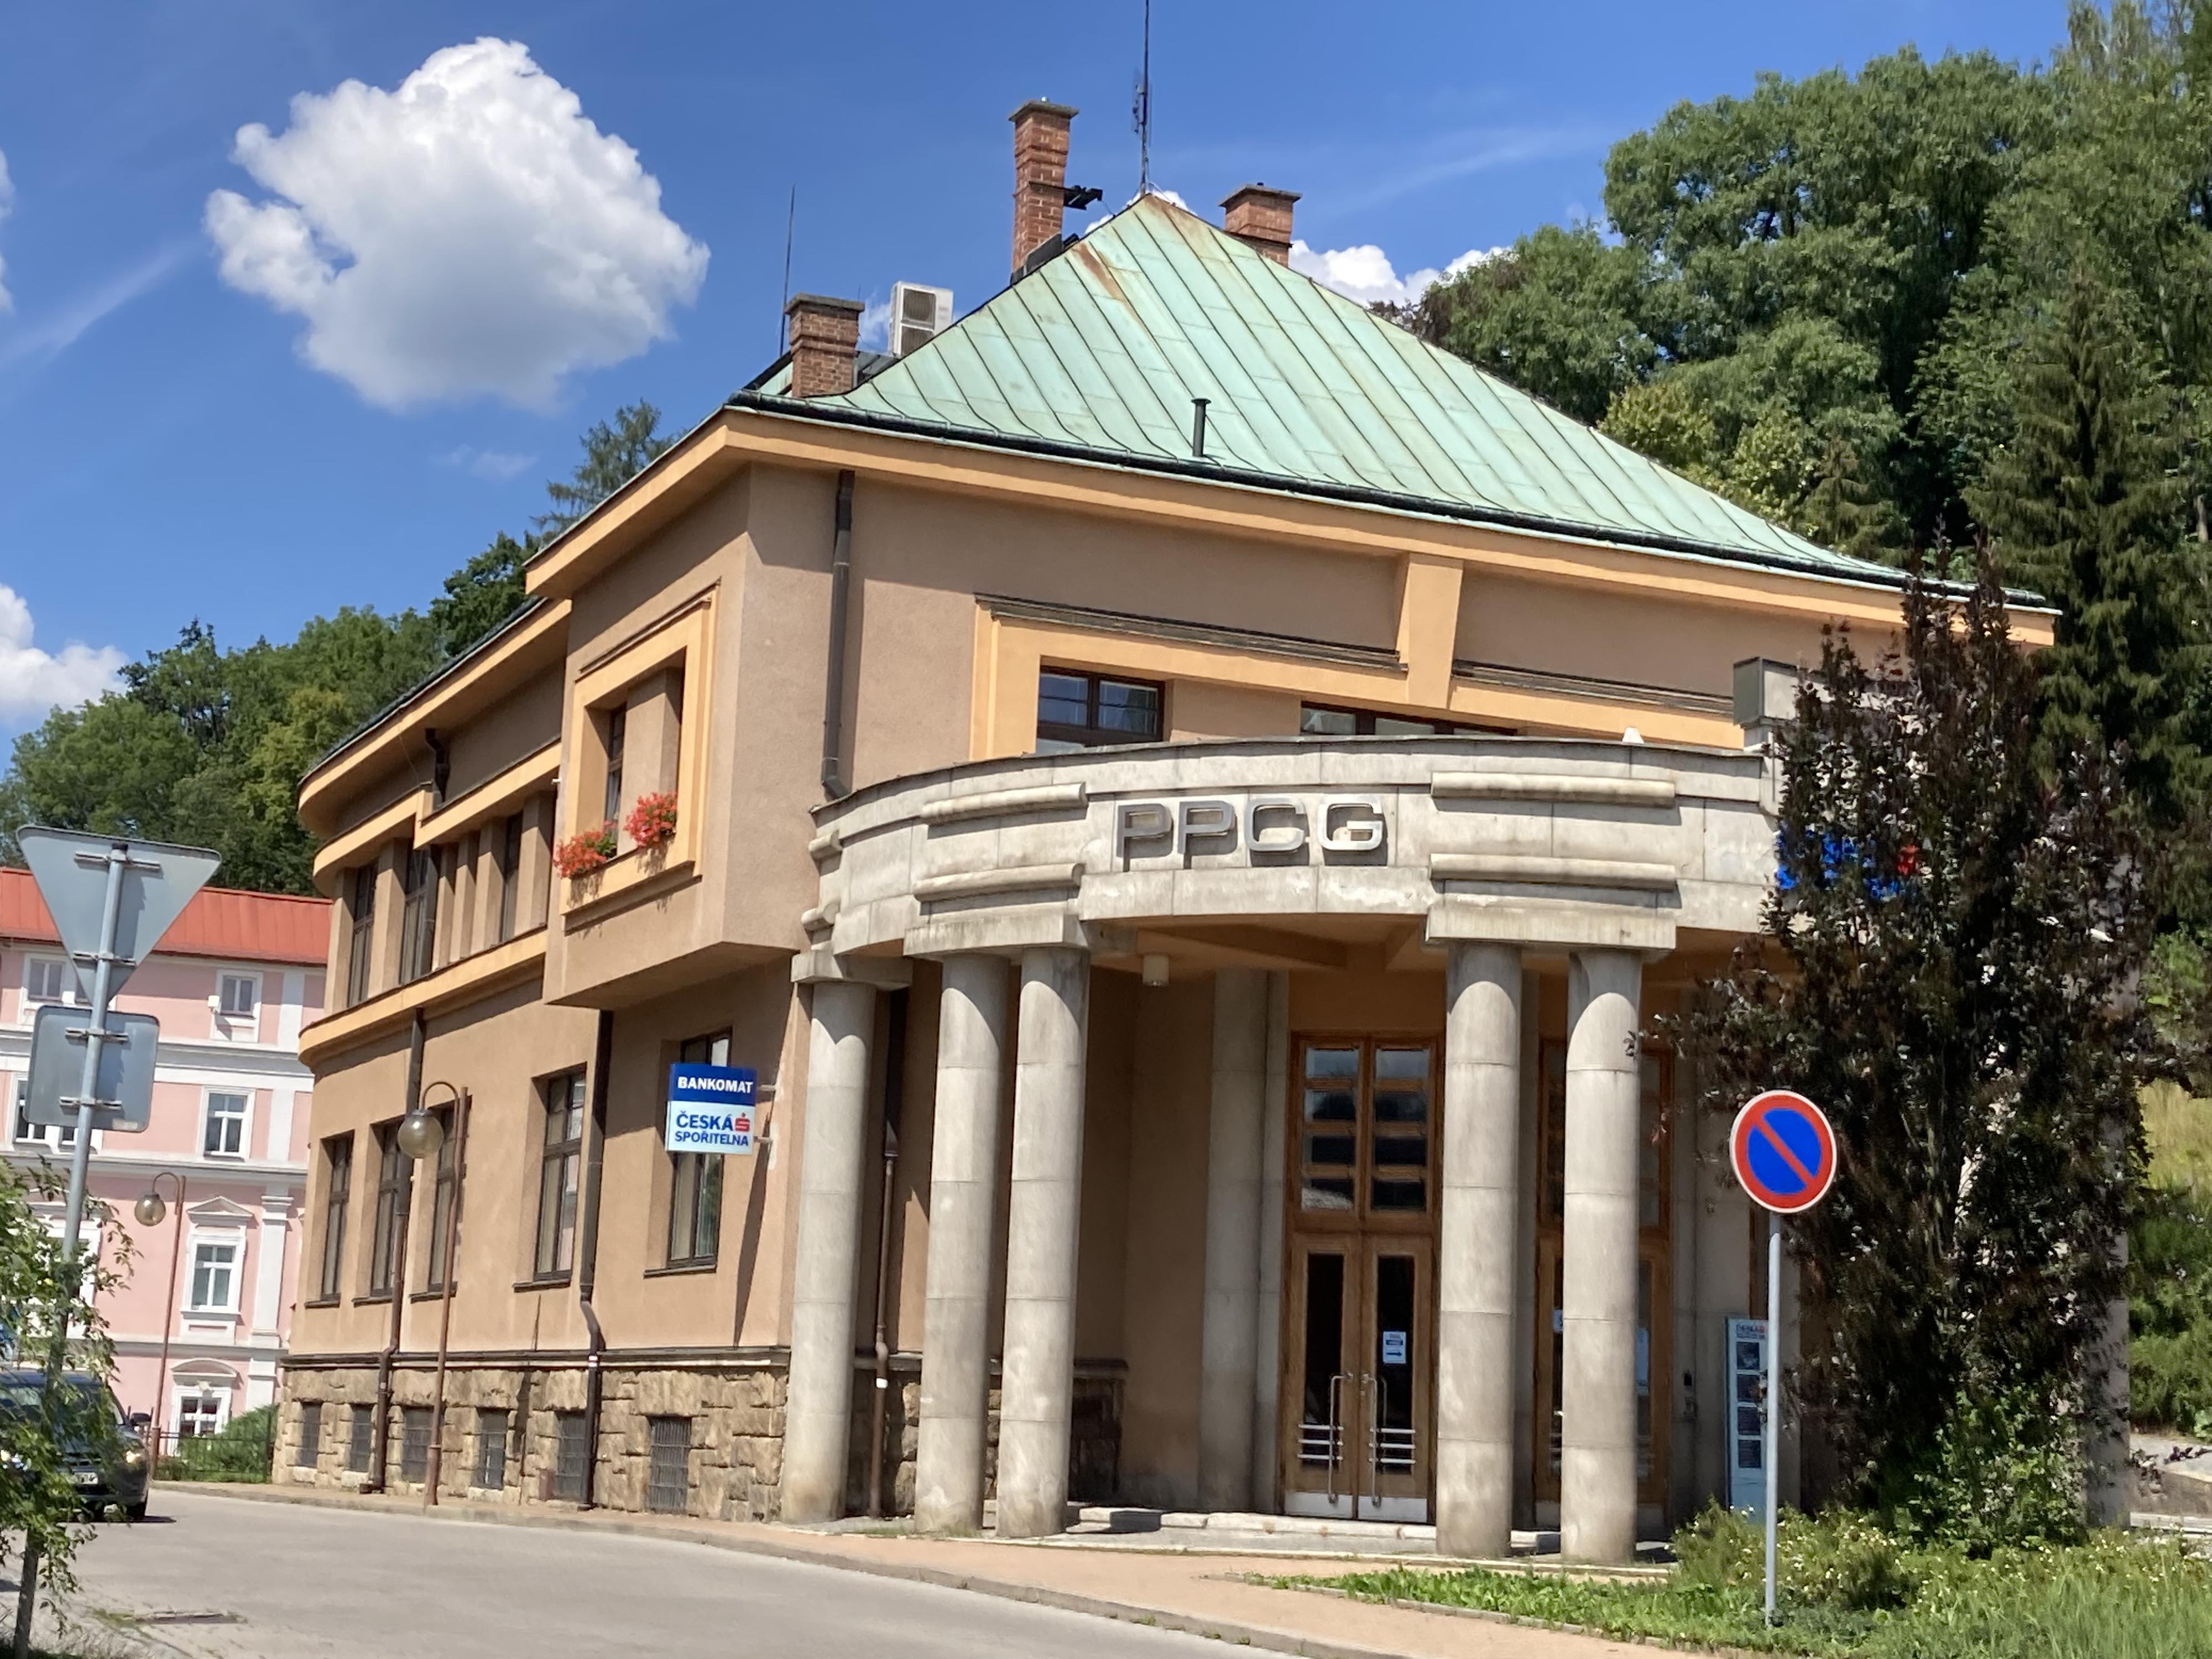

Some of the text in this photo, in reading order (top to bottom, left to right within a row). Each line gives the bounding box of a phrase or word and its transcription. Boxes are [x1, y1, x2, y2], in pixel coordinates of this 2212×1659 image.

[1117, 798, 1383, 858] PPCG
[677, 1077, 753, 1093] BANKOMAT
[676, 1110, 733, 1131] ČESKÁ
[675, 1130, 749, 1146] SPOŘITELNA
